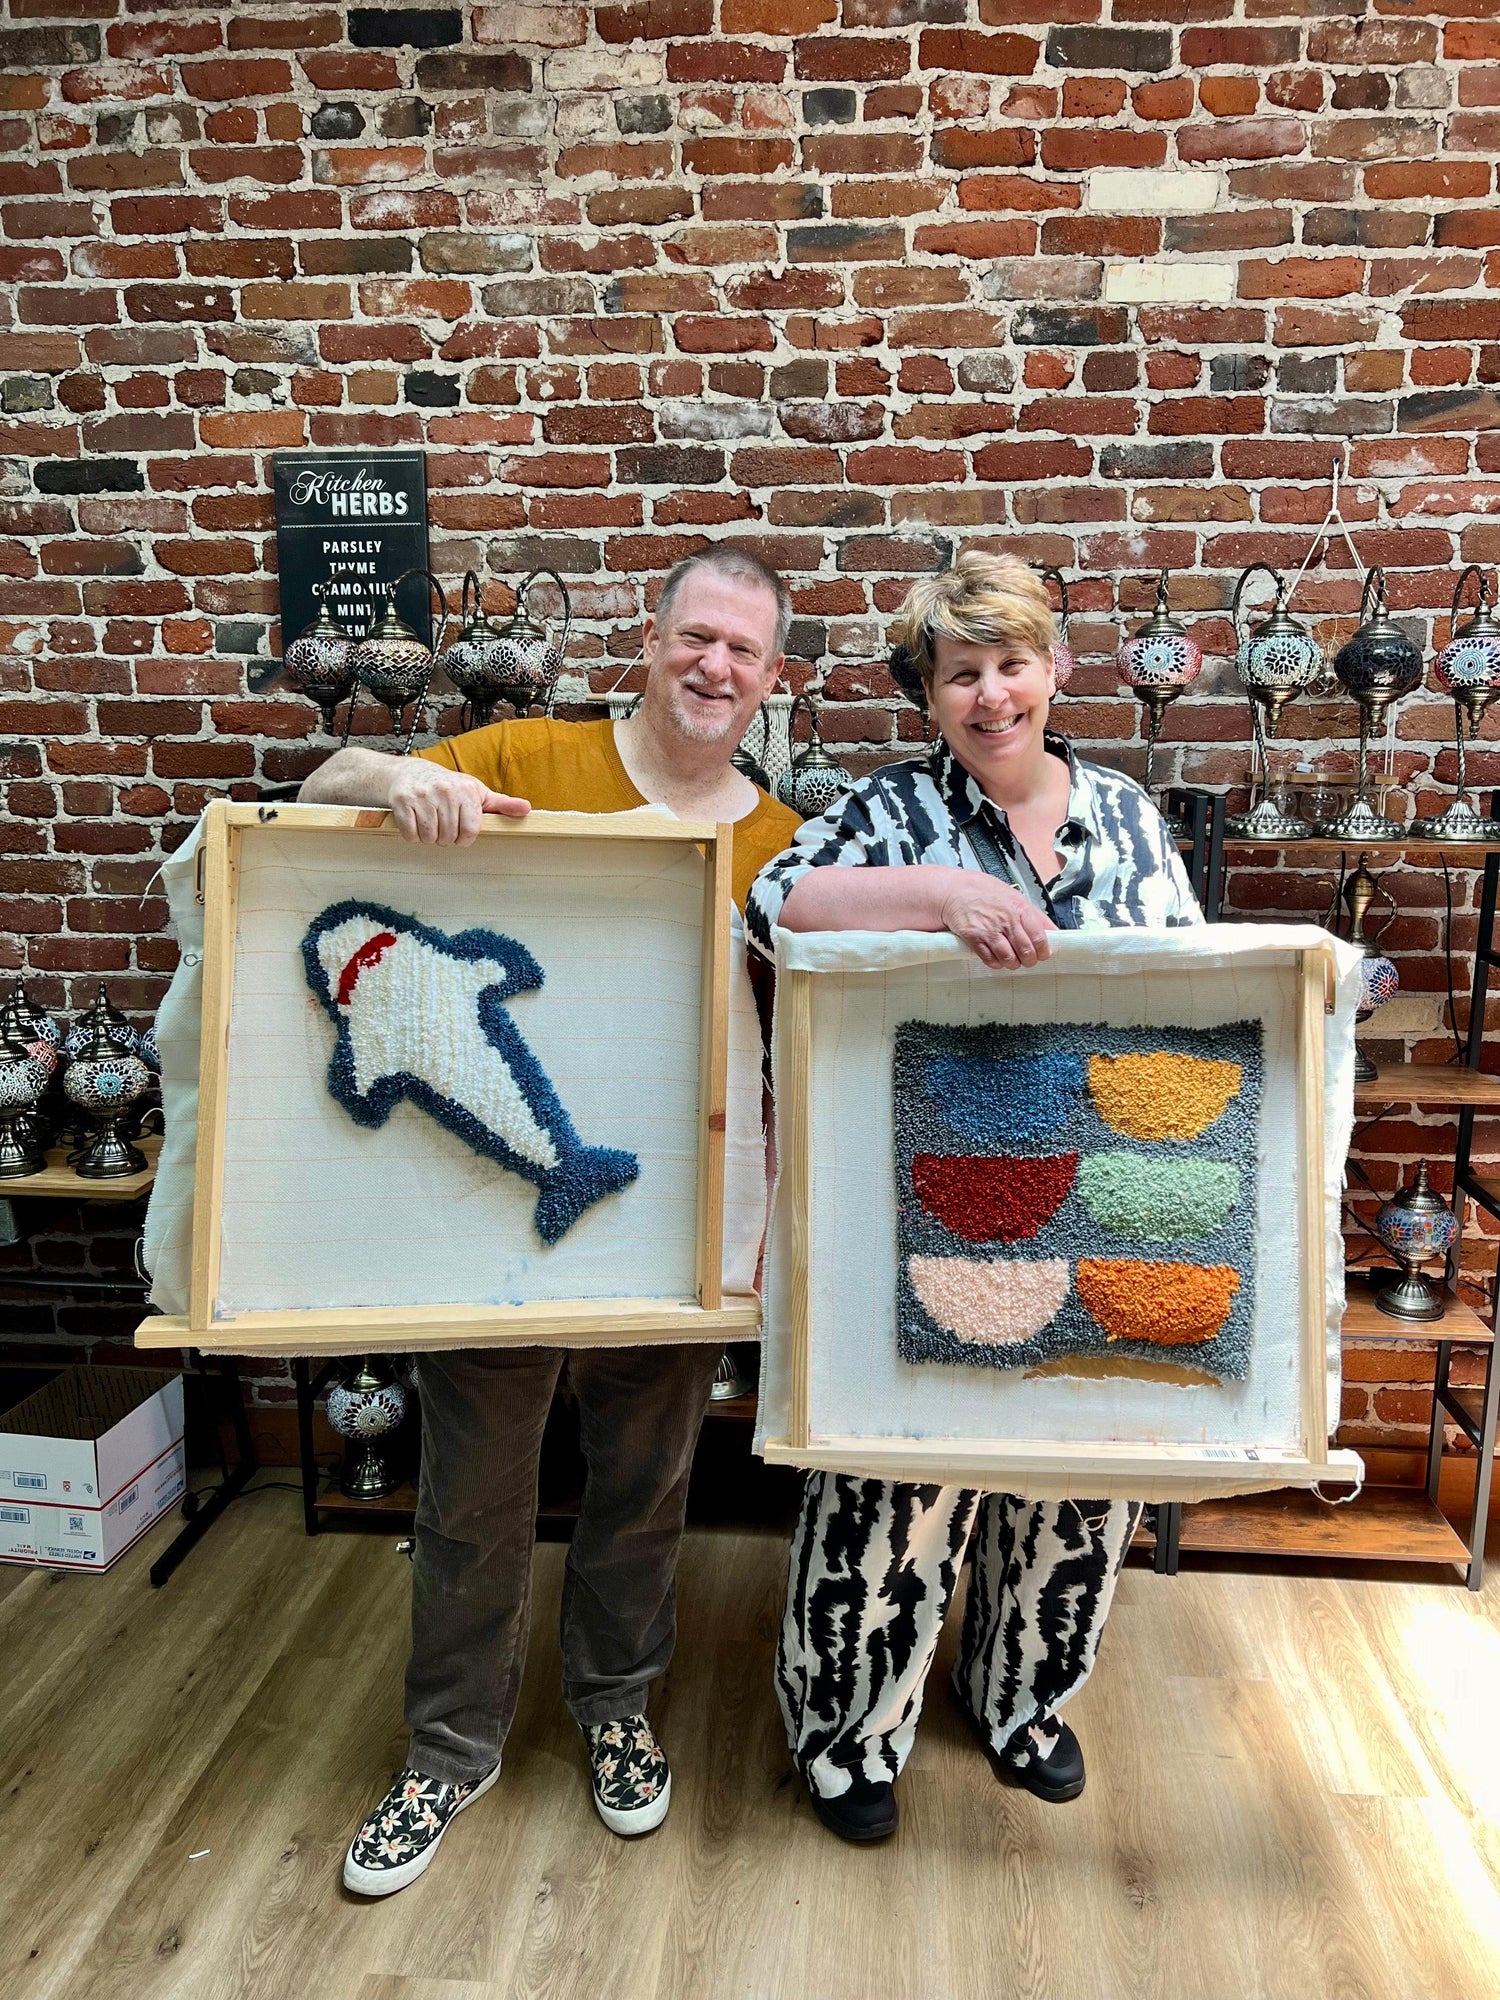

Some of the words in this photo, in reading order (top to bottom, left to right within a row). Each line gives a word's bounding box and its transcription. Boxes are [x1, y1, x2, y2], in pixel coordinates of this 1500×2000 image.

[289, 468, 387, 505] Kitchen
[331, 491, 409, 517] HERBS
[322, 540, 382, 554] PARSLEY
[329, 562, 376, 575] THYME
[337, 604, 371, 616] MINT
